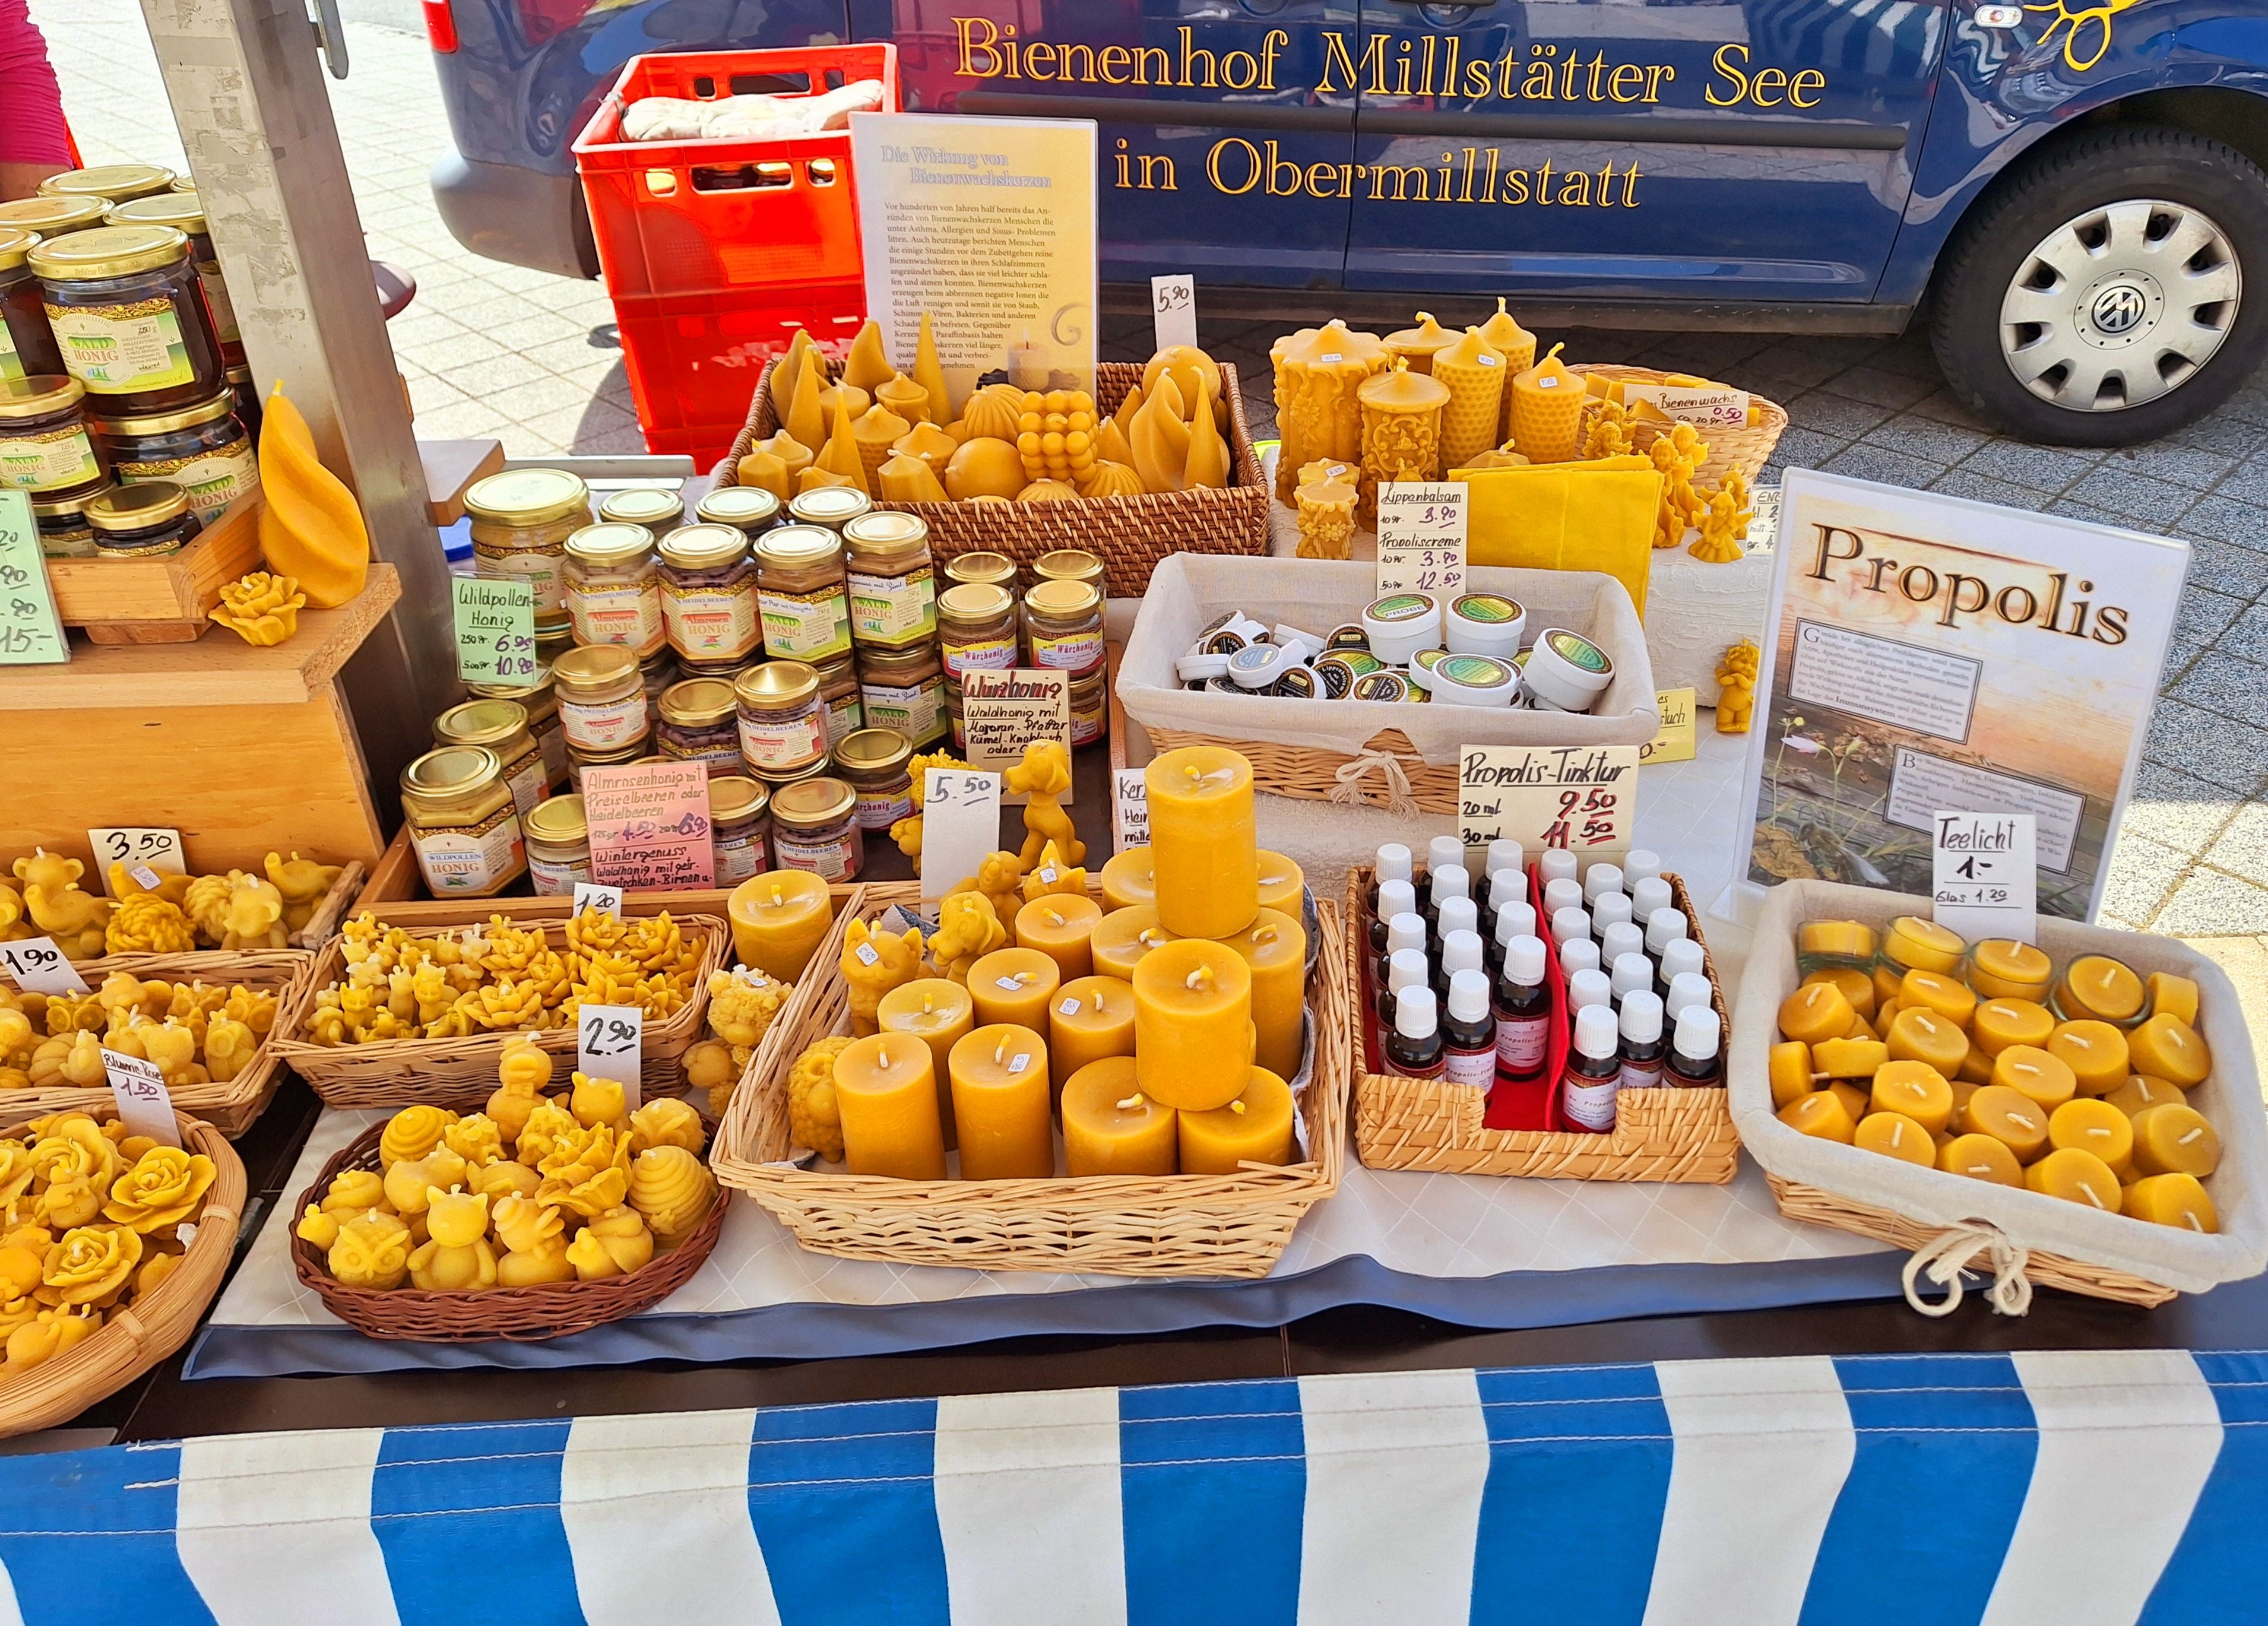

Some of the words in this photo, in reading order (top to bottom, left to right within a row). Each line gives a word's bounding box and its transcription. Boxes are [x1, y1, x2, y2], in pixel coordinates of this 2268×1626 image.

[951, 16, 1288, 90] Bienenhof
[1314, 31, 1675, 103] Millstätter
[1705, 43, 1826, 108] See
[880, 145, 909, 162] Die
[911, 147, 978, 169] Wirkung
[981, 153, 1008, 166] von
[910, 167, 1051, 188] Bienenwachskerzen
[1114, 137, 1179, 191] in
[1206, 137, 1645, 208] Obermillstatt
[955, 204, 978, 213] Jahren
[932, 214, 1002, 224] Bienenwachskerzen
[941, 226, 974, 235] Allergien
[932, 237, 971, 246] heutzutage
[989, 249, 1032, 258] Zubettgehen
[889, 257, 959, 265] Bienenwachskerzen
[978, 280, 1047, 289] Bienenwachskerzen
[924, 300, 952, 309] reinigen
[1158, 286, 1189, 312] 5.90
[74, 337, 109, 349] WALD
[74, 350, 119, 362] HONIG
[1659, 392, 1737, 409] Bienenwachs
[1713, 407, 1743, 421] 0.50
[191, 478, 230, 496] WALD
[1381, 483, 1461, 504] Lippenbalsam
[191, 487, 237, 508] HONIG
[1416, 571, 1461, 590] 12.50
[1805, 522, 2129, 646] Propolis
[857, 598, 888, 609] WALD
[591, 612, 635, 622] Almrosen
[855, 607, 892, 619] HONIG
[1385, 604, 1424, 619] PROBE
[472, 610, 514, 632] Honig
[767, 614, 796, 626] WALD
[594, 623, 637, 633] HONIG
[688, 623, 731, 635] HONIG
[765, 623, 801, 637] HONIG
[965, 648, 1003, 660] Würzhonig
[1057, 641, 1093, 654] Würzhonig
[967, 704, 1034, 722] Waldhonig
[1039, 701, 1060, 717] mit
[1835, 696, 1896, 717] Immunsystem
[872, 717, 910, 727] HONIG
[1462, 748, 1631, 787] Propolis-Tinktur
[587, 768, 683, 790] Almrosenhonig
[686, 765, 702, 782] mit
[587, 790, 675, 807] Preiselbeeren
[681, 786, 704, 800] oder
[926, 776, 991, 803] 5.50
[588, 806, 664, 822] Heidelbeeren
[1462, 801, 1481, 814] 20
[1462, 828, 1481, 844] 30
[1938, 817, 2016, 849] Teelicht
[106, 832, 172, 860] 3.50
[787, 845, 838, 854] HEIDELBEEREN
[595, 846, 687, 863] Wintergenuss
[431, 863, 479, 873] HONIG
[597, 865, 650, 877] Waldhonig
[655, 863, 673, 874] mit
[1936, 891, 1967, 902] Glas
[5, 949, 58, 975] 1.90
